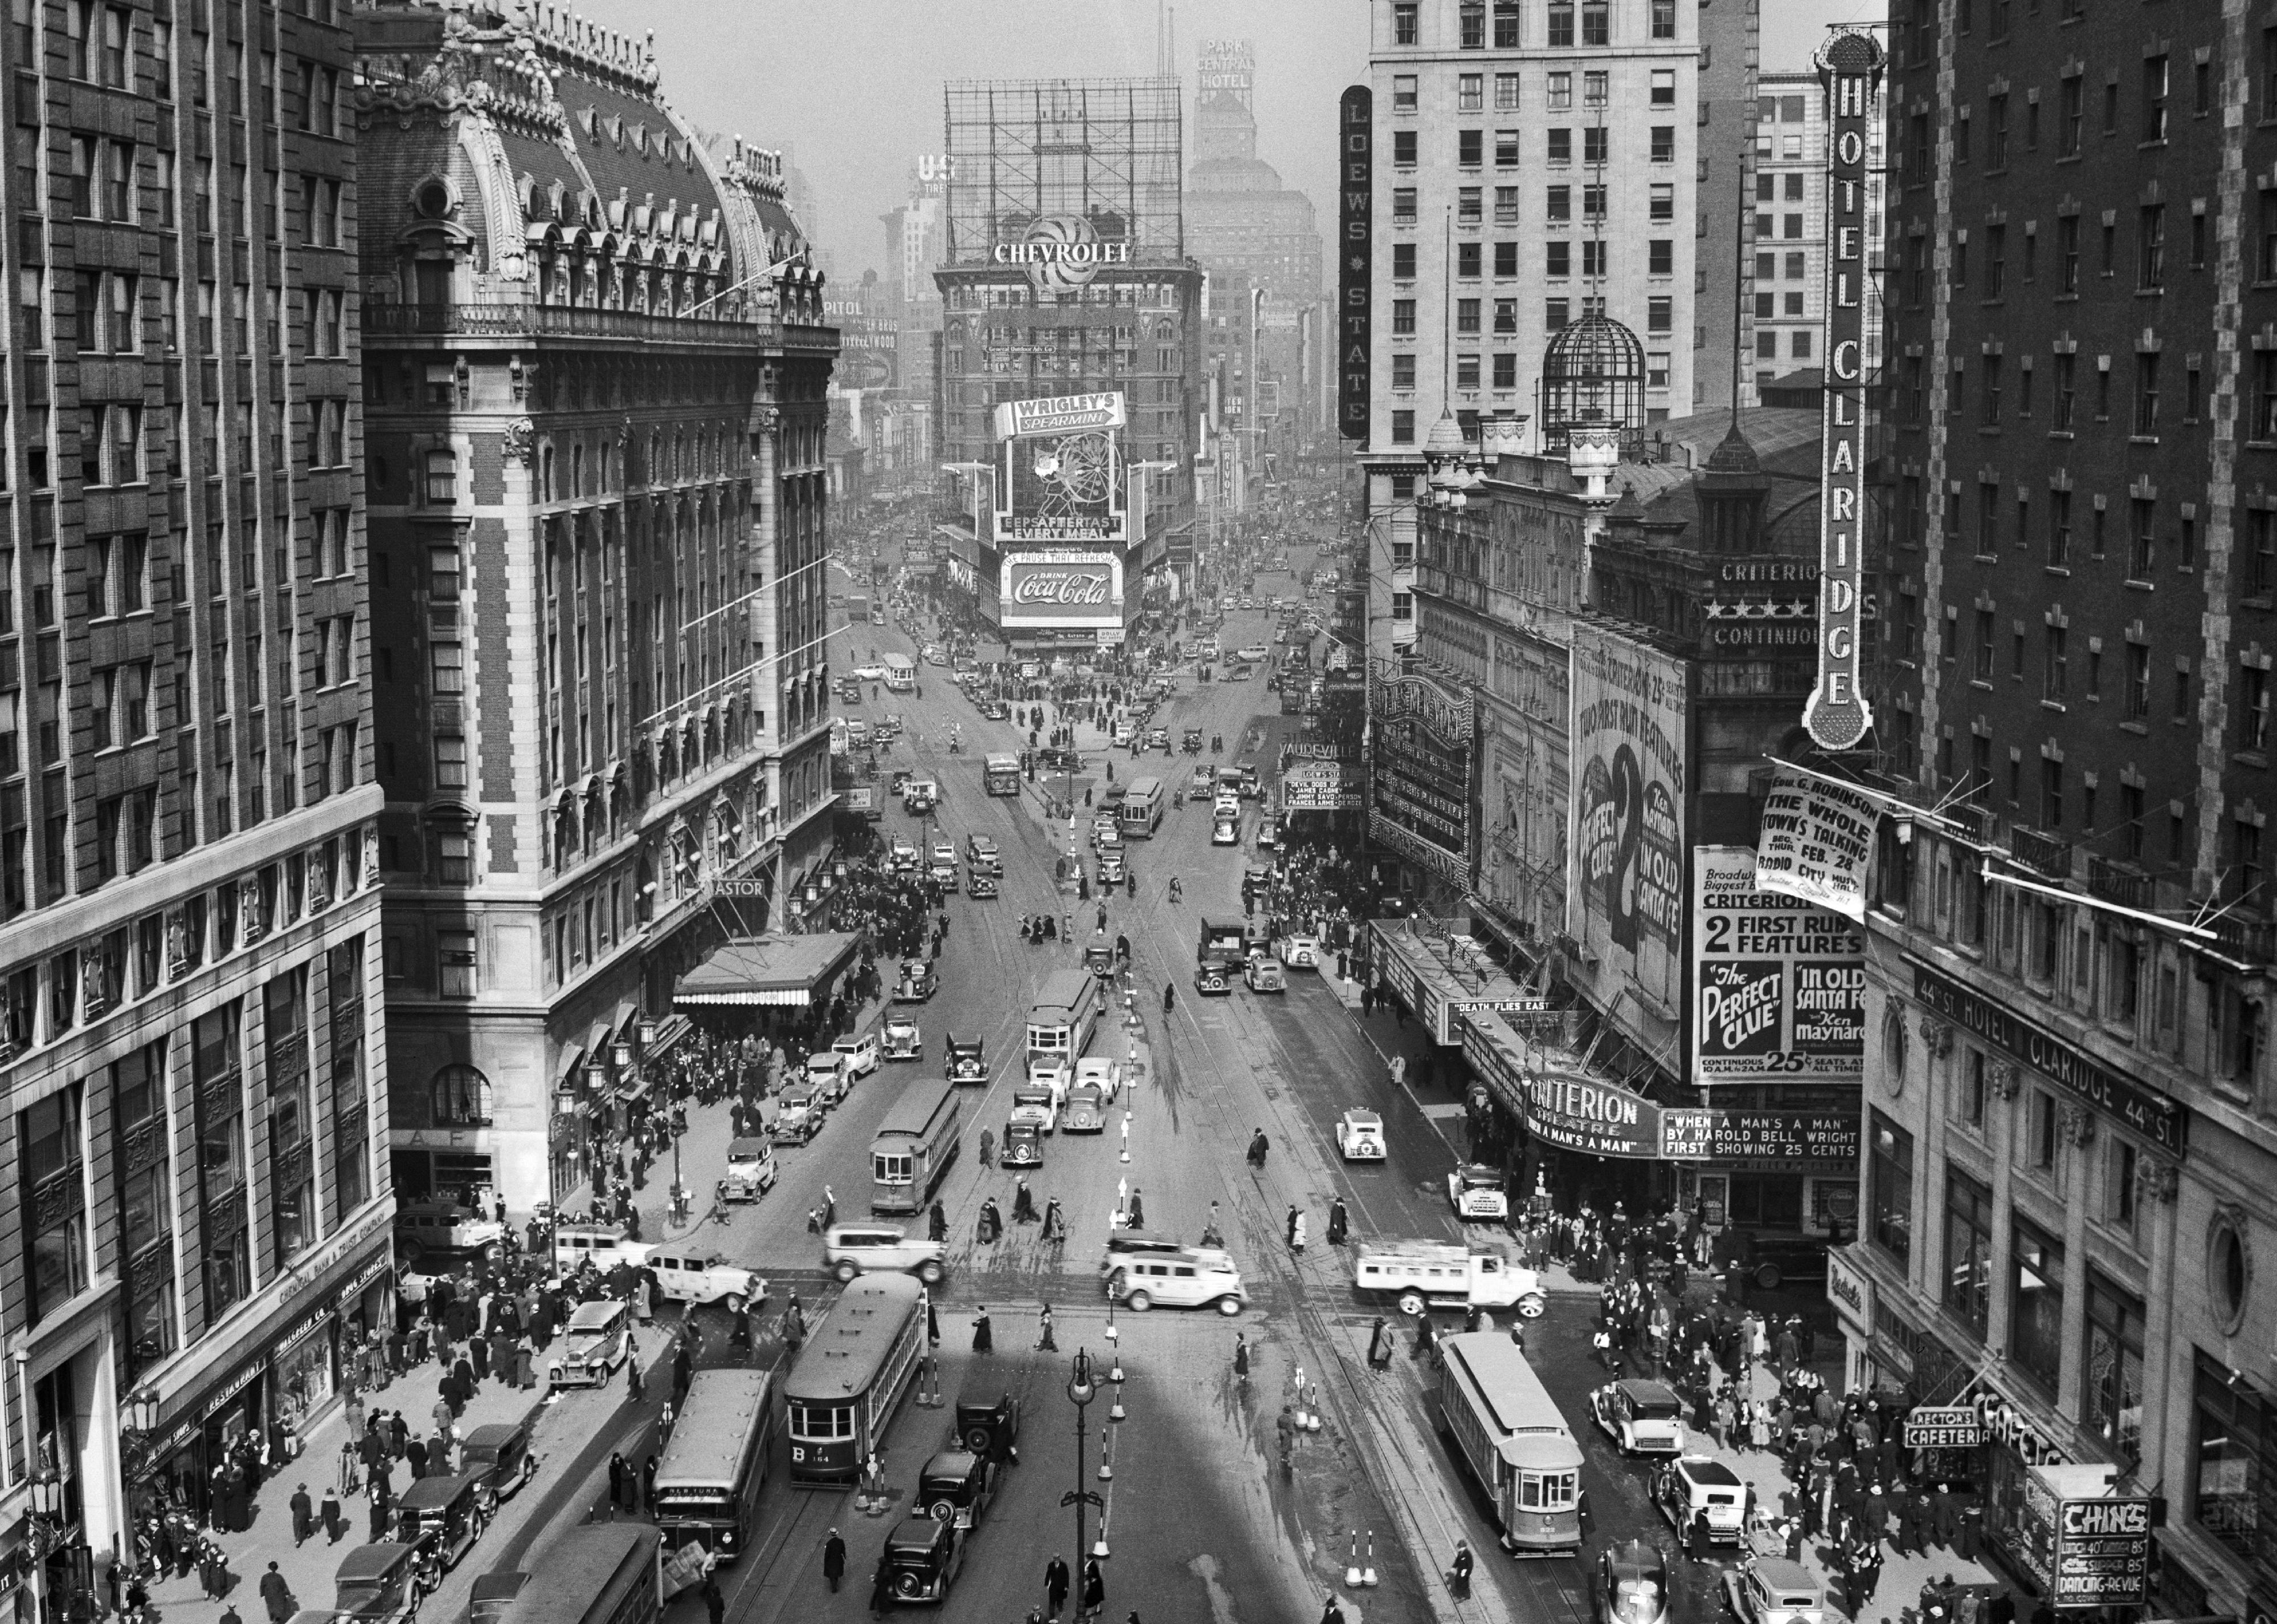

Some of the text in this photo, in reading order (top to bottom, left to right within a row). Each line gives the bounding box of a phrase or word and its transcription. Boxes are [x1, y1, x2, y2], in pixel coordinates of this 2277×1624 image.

[1208, 39, 1244, 54] PARK
[1202, 74, 1249, 88] HOTEL
[1837, 77, 1862, 308] HOTEL
[995, 244, 1130, 263] CHEVROLET
[823, 301, 861, 315] PITOL
[1347, 288, 1367, 420] STATE
[1018, 393, 1115, 416] WRIGLEY'S
[1023, 411, 1106, 430] SPEARMINT
[1015, 528, 1107, 539] EVERY MEAL
[1828, 340, 1859, 706] CLARIDGE
[1003, 554, 1121, 568] THE PAUSE THAT REFRESHES
[1040, 572, 1068, 584] DRINK
[1722, 563, 1817, 581] CRITERIO
[1015, 573, 1110, 605] Coca-Cola
[1715, 628, 1819, 645] CONTINUO
[1798, 779, 1809, 790] G.
[1811, 781, 1878, 821] ROBINSON
[1768, 795, 1870, 844] THE WHOLE
[1763, 813, 1868, 862] TOWN'S TALKING
[1768, 844, 1795, 853] THUR.
[1801, 845, 1854, 871] FEB. 28
[1640, 841, 1679, 895] IN OLD
[1757, 856, 1825, 884] RADIO CITY
[715, 881, 762, 897] ASTOR
[1666, 900, 1679, 935] FE
[1704, 915, 1852, 952] 2 FIRST RUN
[1738, 935, 1862, 954] FEATURES
[1825, 968, 1866, 989] OLD
[747, 993, 778, 1001] ASTOR
[1495, 1003, 1520, 1011] FLIES
[1796, 989, 1846, 1010] SANTA
[1702, 973, 1781, 1045] PERFECT
[1818, 1010, 1851, 1026] Ken
[1965, 999, 2009, 1047] HOTEL
[2030, 1034, 2112, 1108] CLARIDGE
[1531, 1078, 1637, 1125] CRITERION
[1537, 1107, 1621, 1136] THEATRE
[1722, 1118, 1730, 1128] A
[1741, 1118, 1783, 1129] MAN'S
[1793, 1119, 1802, 1129] A
[411, 1130, 502, 1146] AFE
[1543, 1126, 1548, 1136] A
[1551, 1128, 1583, 1146] MAN'S
[1588, 1137, 1596, 1149] A
[1666, 1130, 1857, 1143] BY HAROLD BELL WRIGHT
[1666, 1142, 1855, 1156] FIRST SHOWING 25 CENTS
[339, 1235, 357, 1258] TRUST
[359, 1212, 385, 1241] COMPANY
[278, 1319, 312, 1353] WALGREEN
[359, 1258, 384, 1283] STORES
[209, 1361, 261, 1412] RESTAURANT
[1916, 1412, 1972, 1425] RECTOR'S
[1910, 1428, 1990, 1444] CAFETERIA
[792, 1447, 805, 1462] B
[2064, 1504, 2147, 1533] CHIN'S
